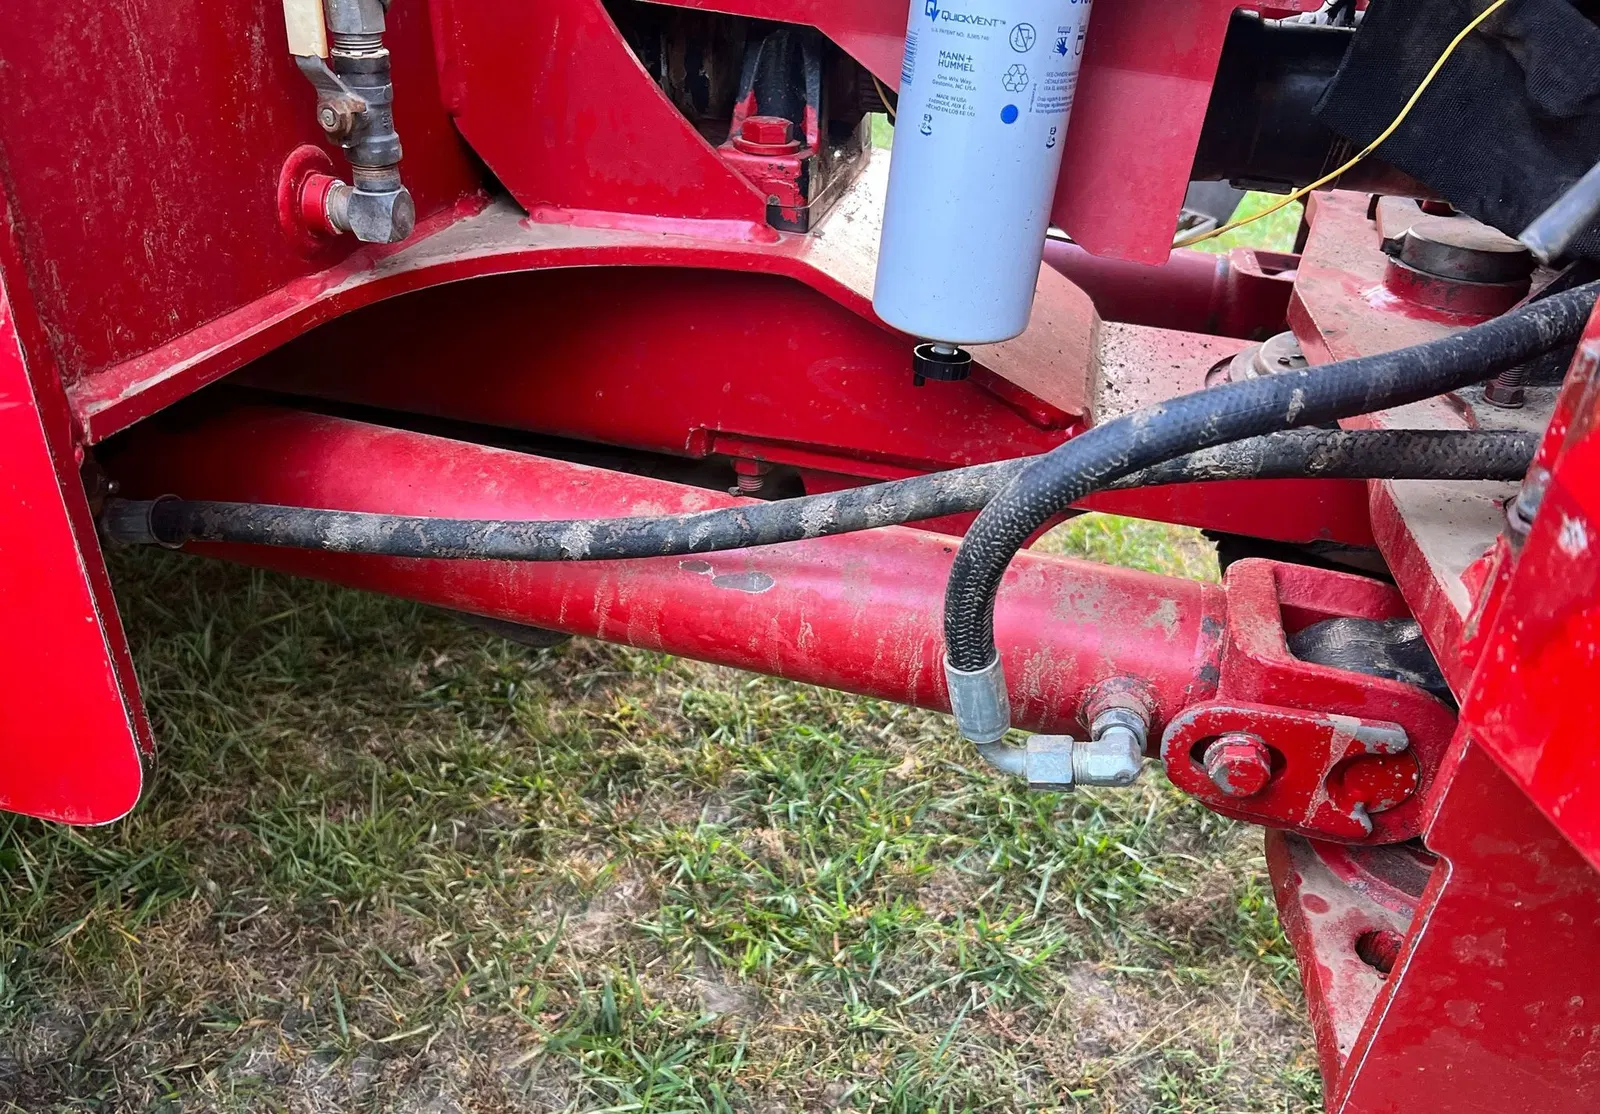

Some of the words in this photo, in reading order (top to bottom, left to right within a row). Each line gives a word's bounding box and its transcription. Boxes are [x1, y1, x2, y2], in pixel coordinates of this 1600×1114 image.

[939, 28, 955, 36] PATENT
[938, 59, 975, 72] HUMMEL
[960, 77, 972, 85] Way
[955, 82, 963, 90] NC
[926, 103, 941, 112] HECHO
